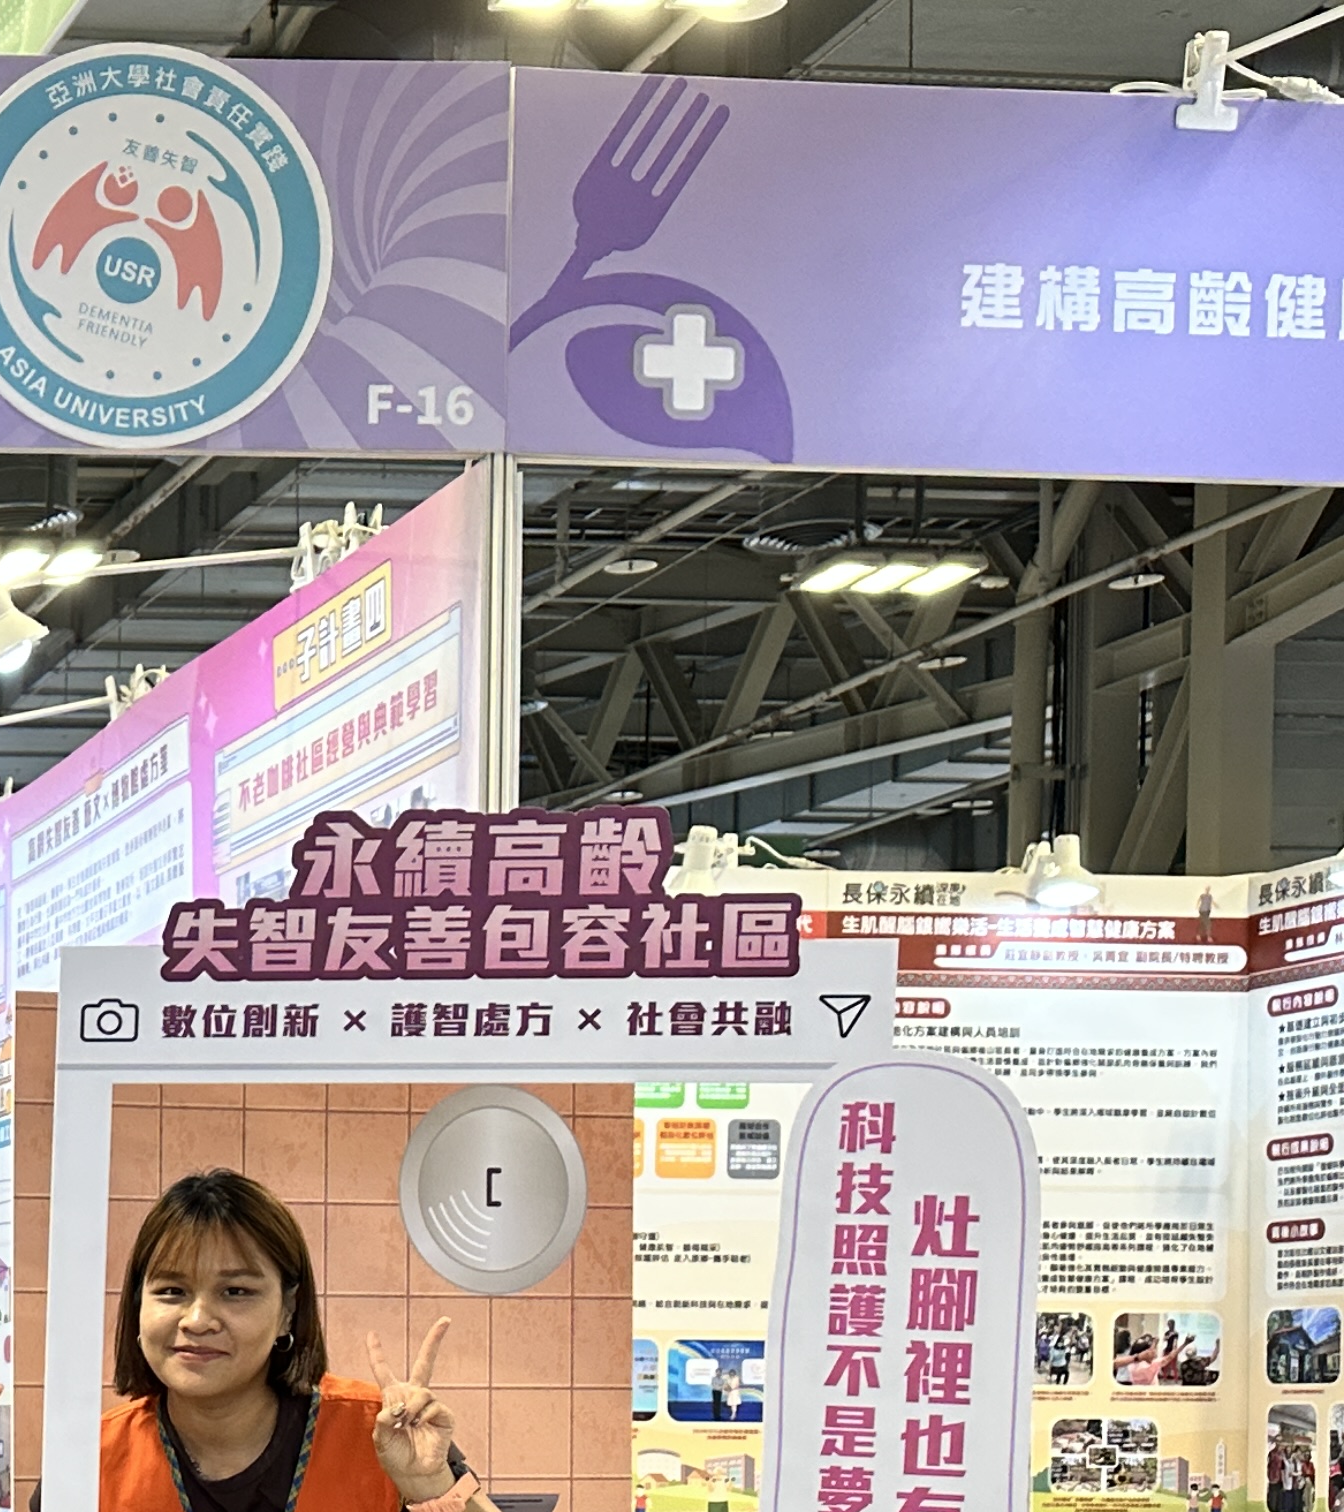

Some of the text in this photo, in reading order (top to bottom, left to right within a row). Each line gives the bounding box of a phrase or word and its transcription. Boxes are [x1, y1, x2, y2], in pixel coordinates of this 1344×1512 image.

[45, 64, 297, 174] 亞洲大學社會責任實踐
[123, 138, 200, 175] 友善失智
[104, 254, 155, 288] USR
[78, 302, 154, 334] DEMENTIA
[961, 262, 1344, 342] 建構高齡健
[77, 319, 149, 348] FRIENDLY
[53, 386, 208, 429] UNIVERSITY
[367, 384, 475, 427] F-16
[296, 577, 386, 684] 子計畫四
[303, 815, 663, 898] 永續高齡
[169, 902, 793, 974] 失智友善包容社區
[161, 1003, 320, 1039] 數位創新
[391, 1002, 553, 1038] 護智處方
[627, 1001, 794, 1037] 社會共融
